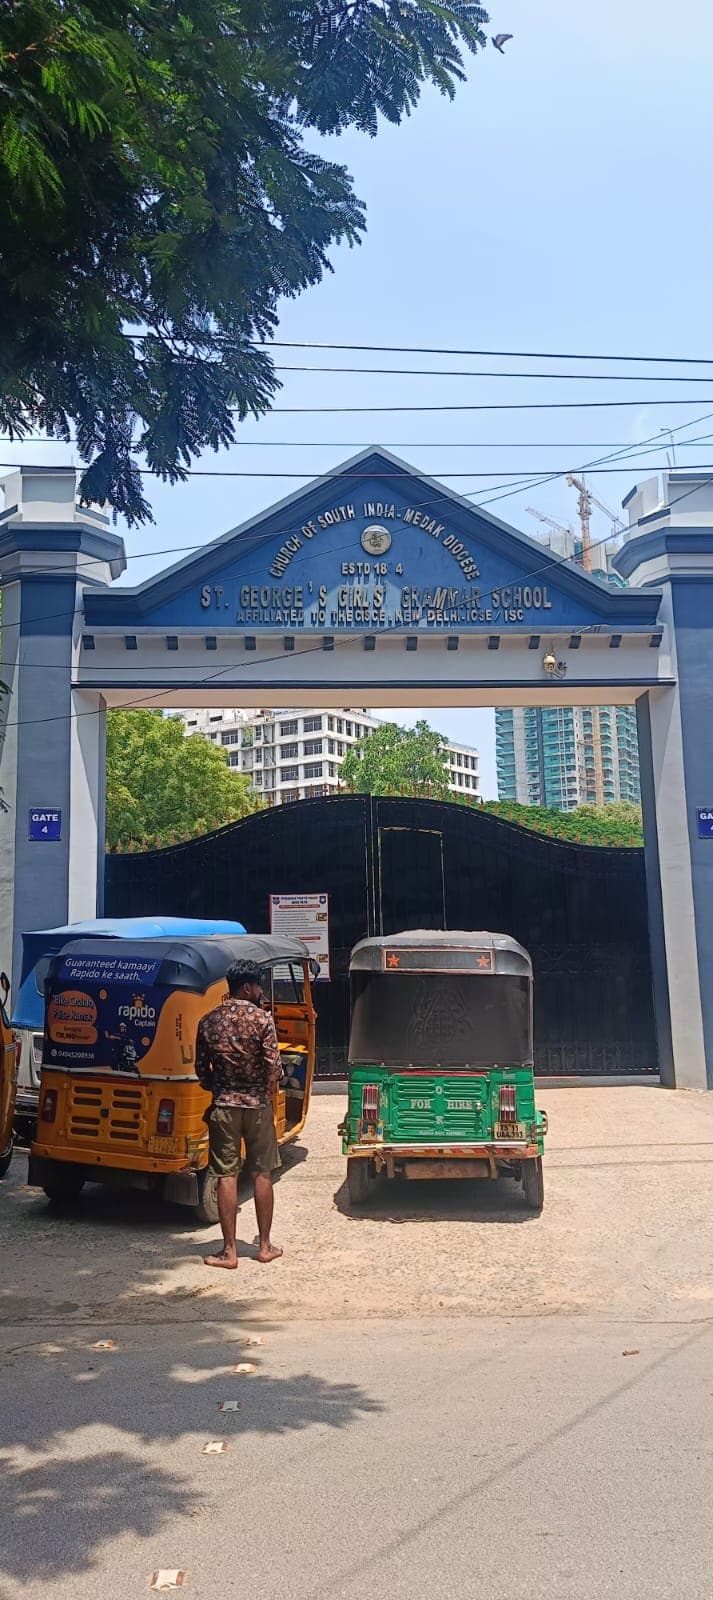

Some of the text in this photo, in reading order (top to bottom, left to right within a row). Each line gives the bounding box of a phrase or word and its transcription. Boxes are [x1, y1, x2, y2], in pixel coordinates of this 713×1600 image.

[269, 534, 304, 578] CHURCH
[301, 520, 318, 539] OF
[317, 504, 356, 529] SOUTH
[442, 533, 481, 581] DIOCESE
[341, 562, 371, 575] ESTD
[201, 584, 230, 608] ST.
[491, 585, 552, 608] SCHOOL
[236, 609, 305, 622] AFFILIATED
[310, 609, 326, 622] TO
[31, 813, 60, 823] GATE
[41, 826, 49, 835] 4
[65, 958, 157, 973] Guaranteed kamaayi
[70, 968, 101, 980] Rapido
[101, 970, 113, 979] ke
[118, 1004, 156, 1021] rapido
[134, 1018, 156, 1029] Captain
[410, 1099, 473, 1110] FOR HIRE
